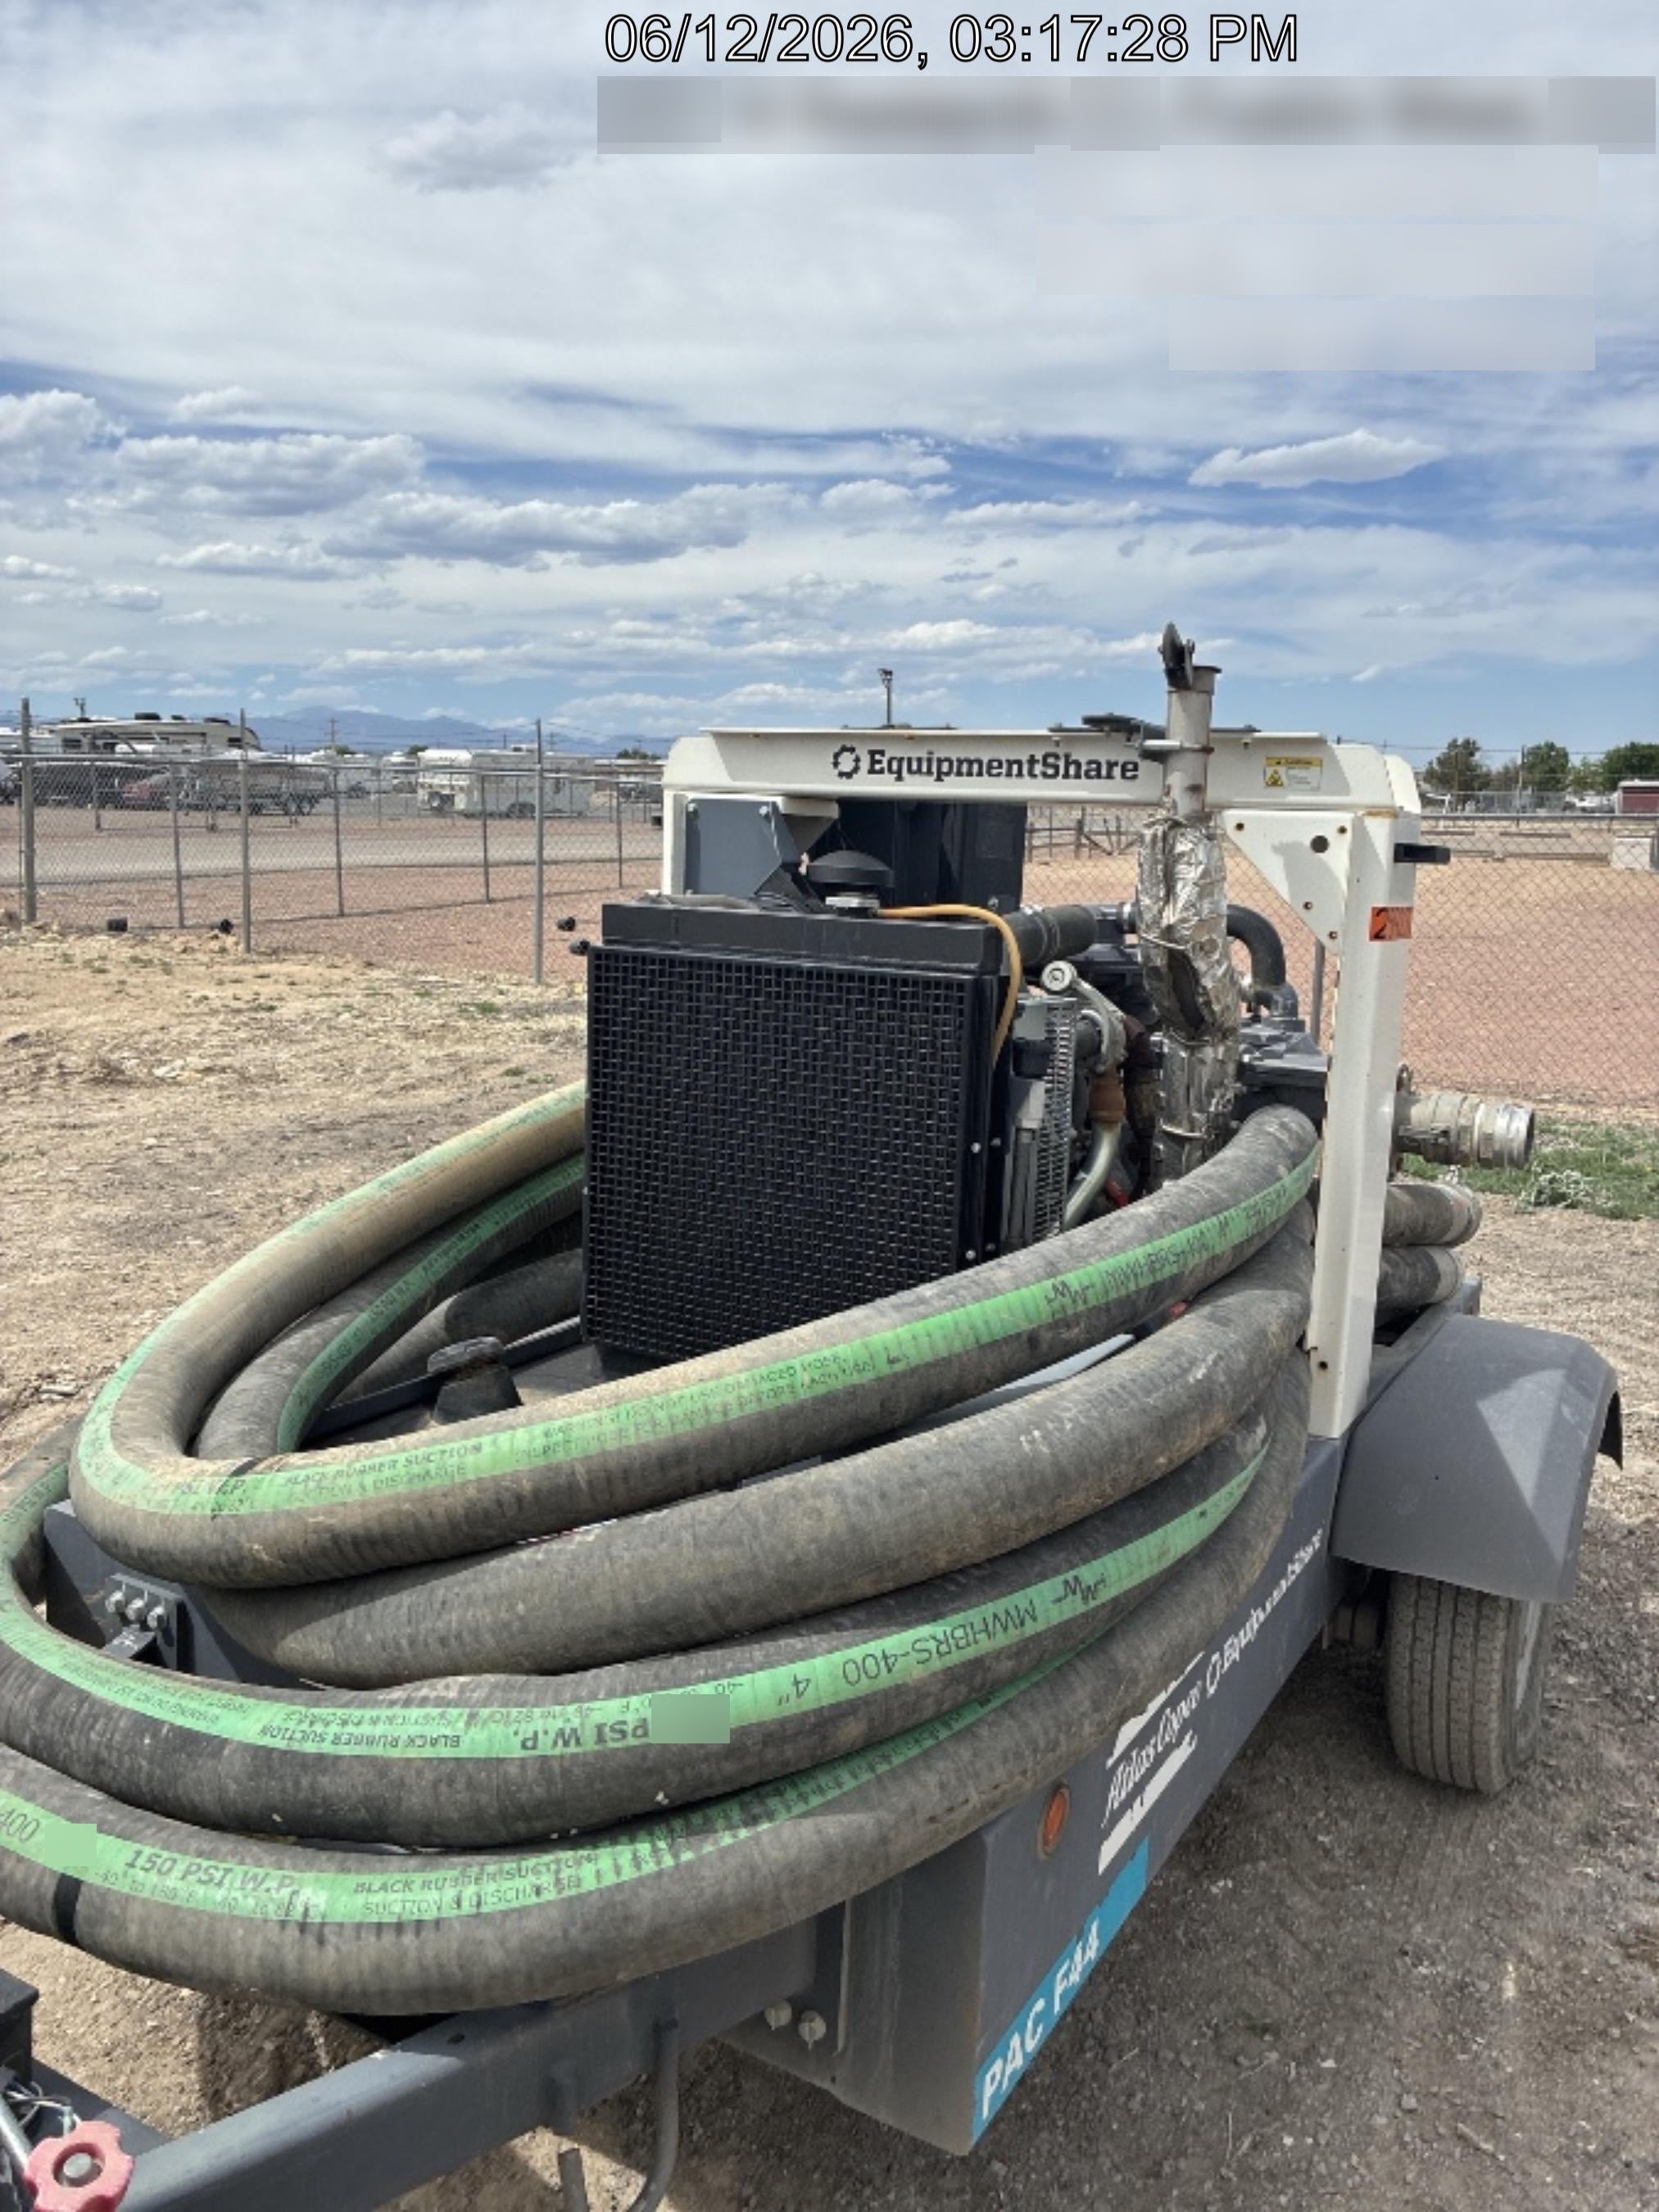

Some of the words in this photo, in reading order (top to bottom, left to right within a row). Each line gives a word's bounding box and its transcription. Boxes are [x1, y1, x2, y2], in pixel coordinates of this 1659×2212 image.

[867, 747, 1140, 783] EquipmentShare
[403, 1442, 484, 1466] SUCTION
[841, 1598, 1040, 1686] MWHBRS-400
[259, 1724, 328, 1746] SUCTION
[330, 1729, 401, 1750] RUBBER
[405, 1732, 461, 1750] BLACK
[512, 1726, 582, 1752] W.P.
[595, 1716, 650, 1743] PSI
[1101, 1734, 1157, 1829] Atlas
[1157, 1679, 1203, 1754] Copco
[125, 1848, 177, 1876] 150
[179, 1857, 237, 1889] PSI
[238, 1870, 300, 1899] W.P.
[354, 1878, 415, 1895] BLACK
[419, 1870, 498, 1894] RUBBER
[502, 1852, 596, 1881] SUCTION
[363, 1897, 443, 1917] SUCTION
[468, 1876, 582, 1912] DISCHARGE
[982, 1997, 1046, 2119] PAC
[1054, 1918, 1100, 2015] F44
